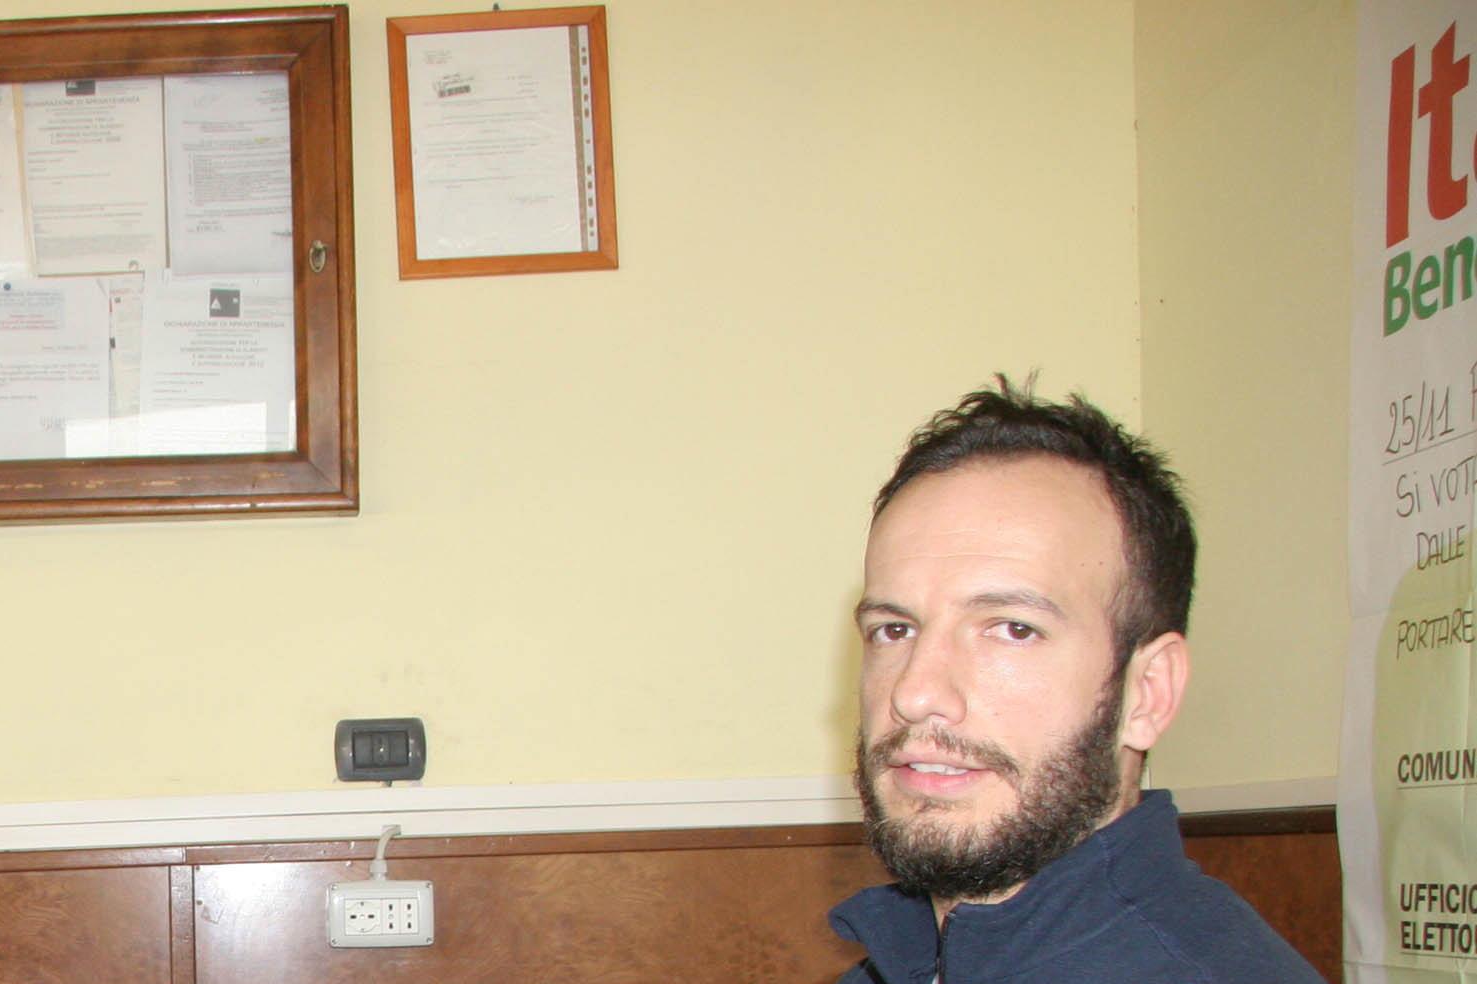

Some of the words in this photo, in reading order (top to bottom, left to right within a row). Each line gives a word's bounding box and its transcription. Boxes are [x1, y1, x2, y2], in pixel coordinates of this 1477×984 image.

[1386, 20, 1477, 249] It
[1383, 236, 1477, 338] Ben
[1385, 380, 1454, 453] 25/11
[1416, 525, 1465, 570] DALLE
[1397, 608, 1476, 660] PORTARE
[1401, 920, 1477, 954] ELETTO
